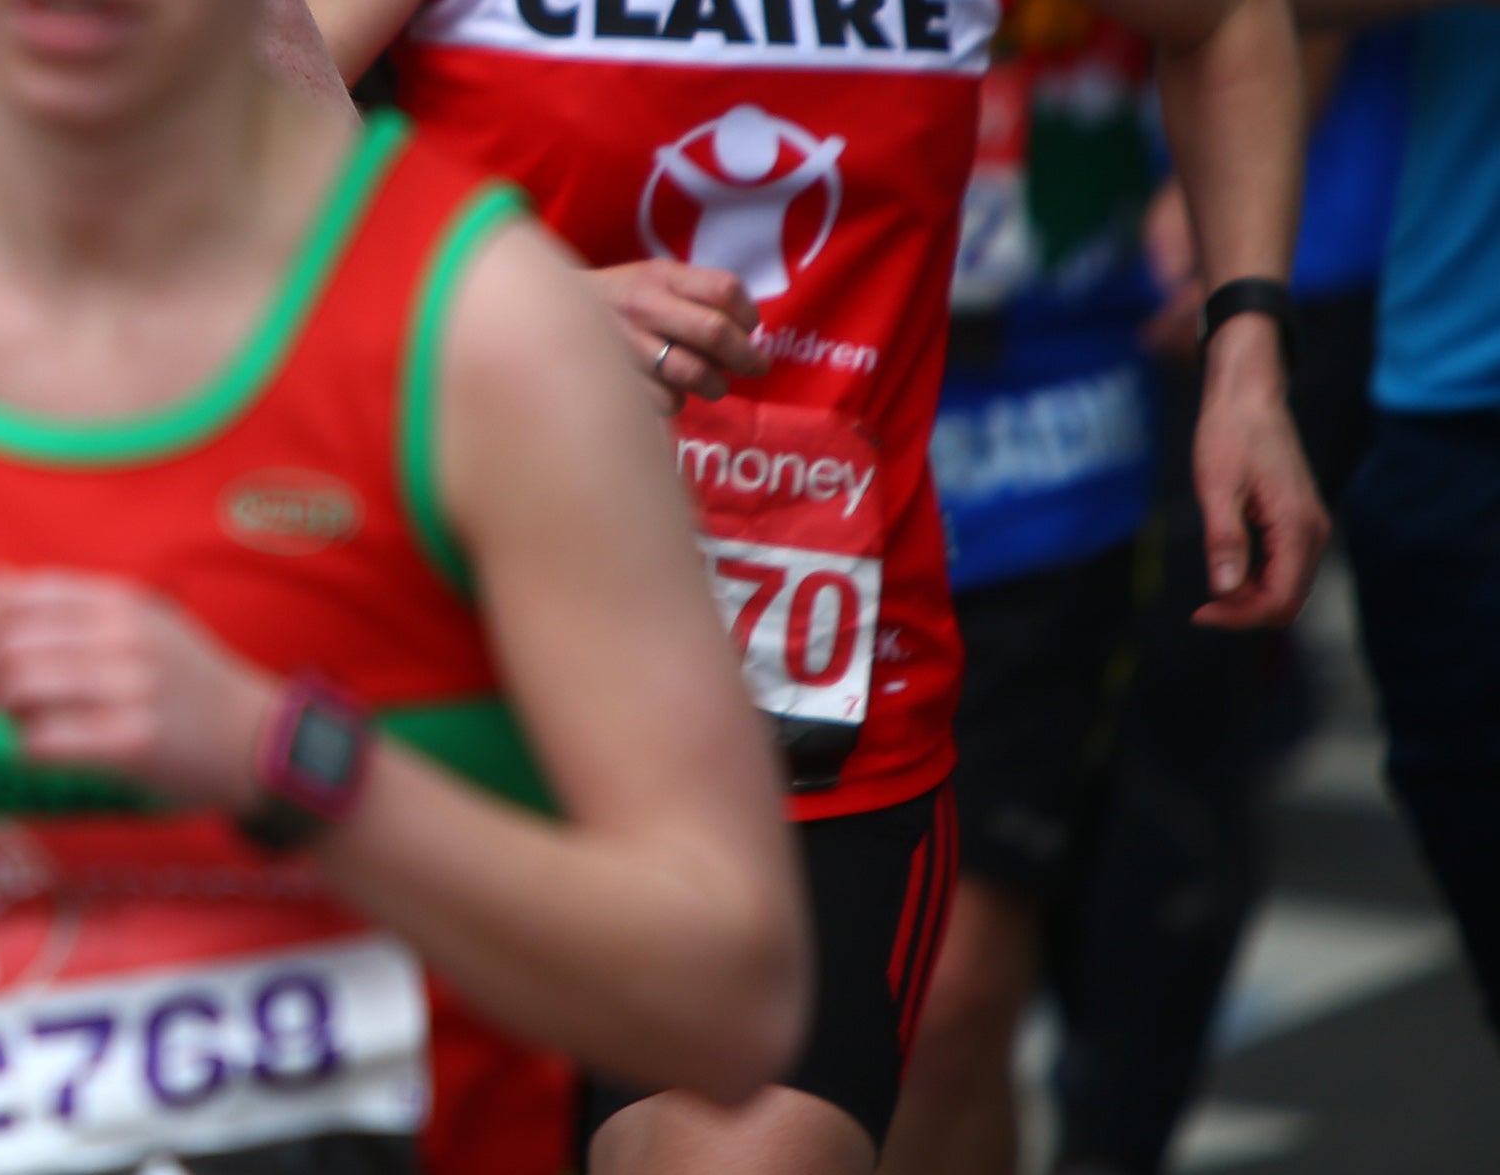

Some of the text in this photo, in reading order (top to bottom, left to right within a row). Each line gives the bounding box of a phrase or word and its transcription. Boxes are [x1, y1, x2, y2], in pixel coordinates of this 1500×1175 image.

[750, 322, 879, 374] hildren
[675, 437, 876, 519] money
[714, 559, 861, 688] 70
